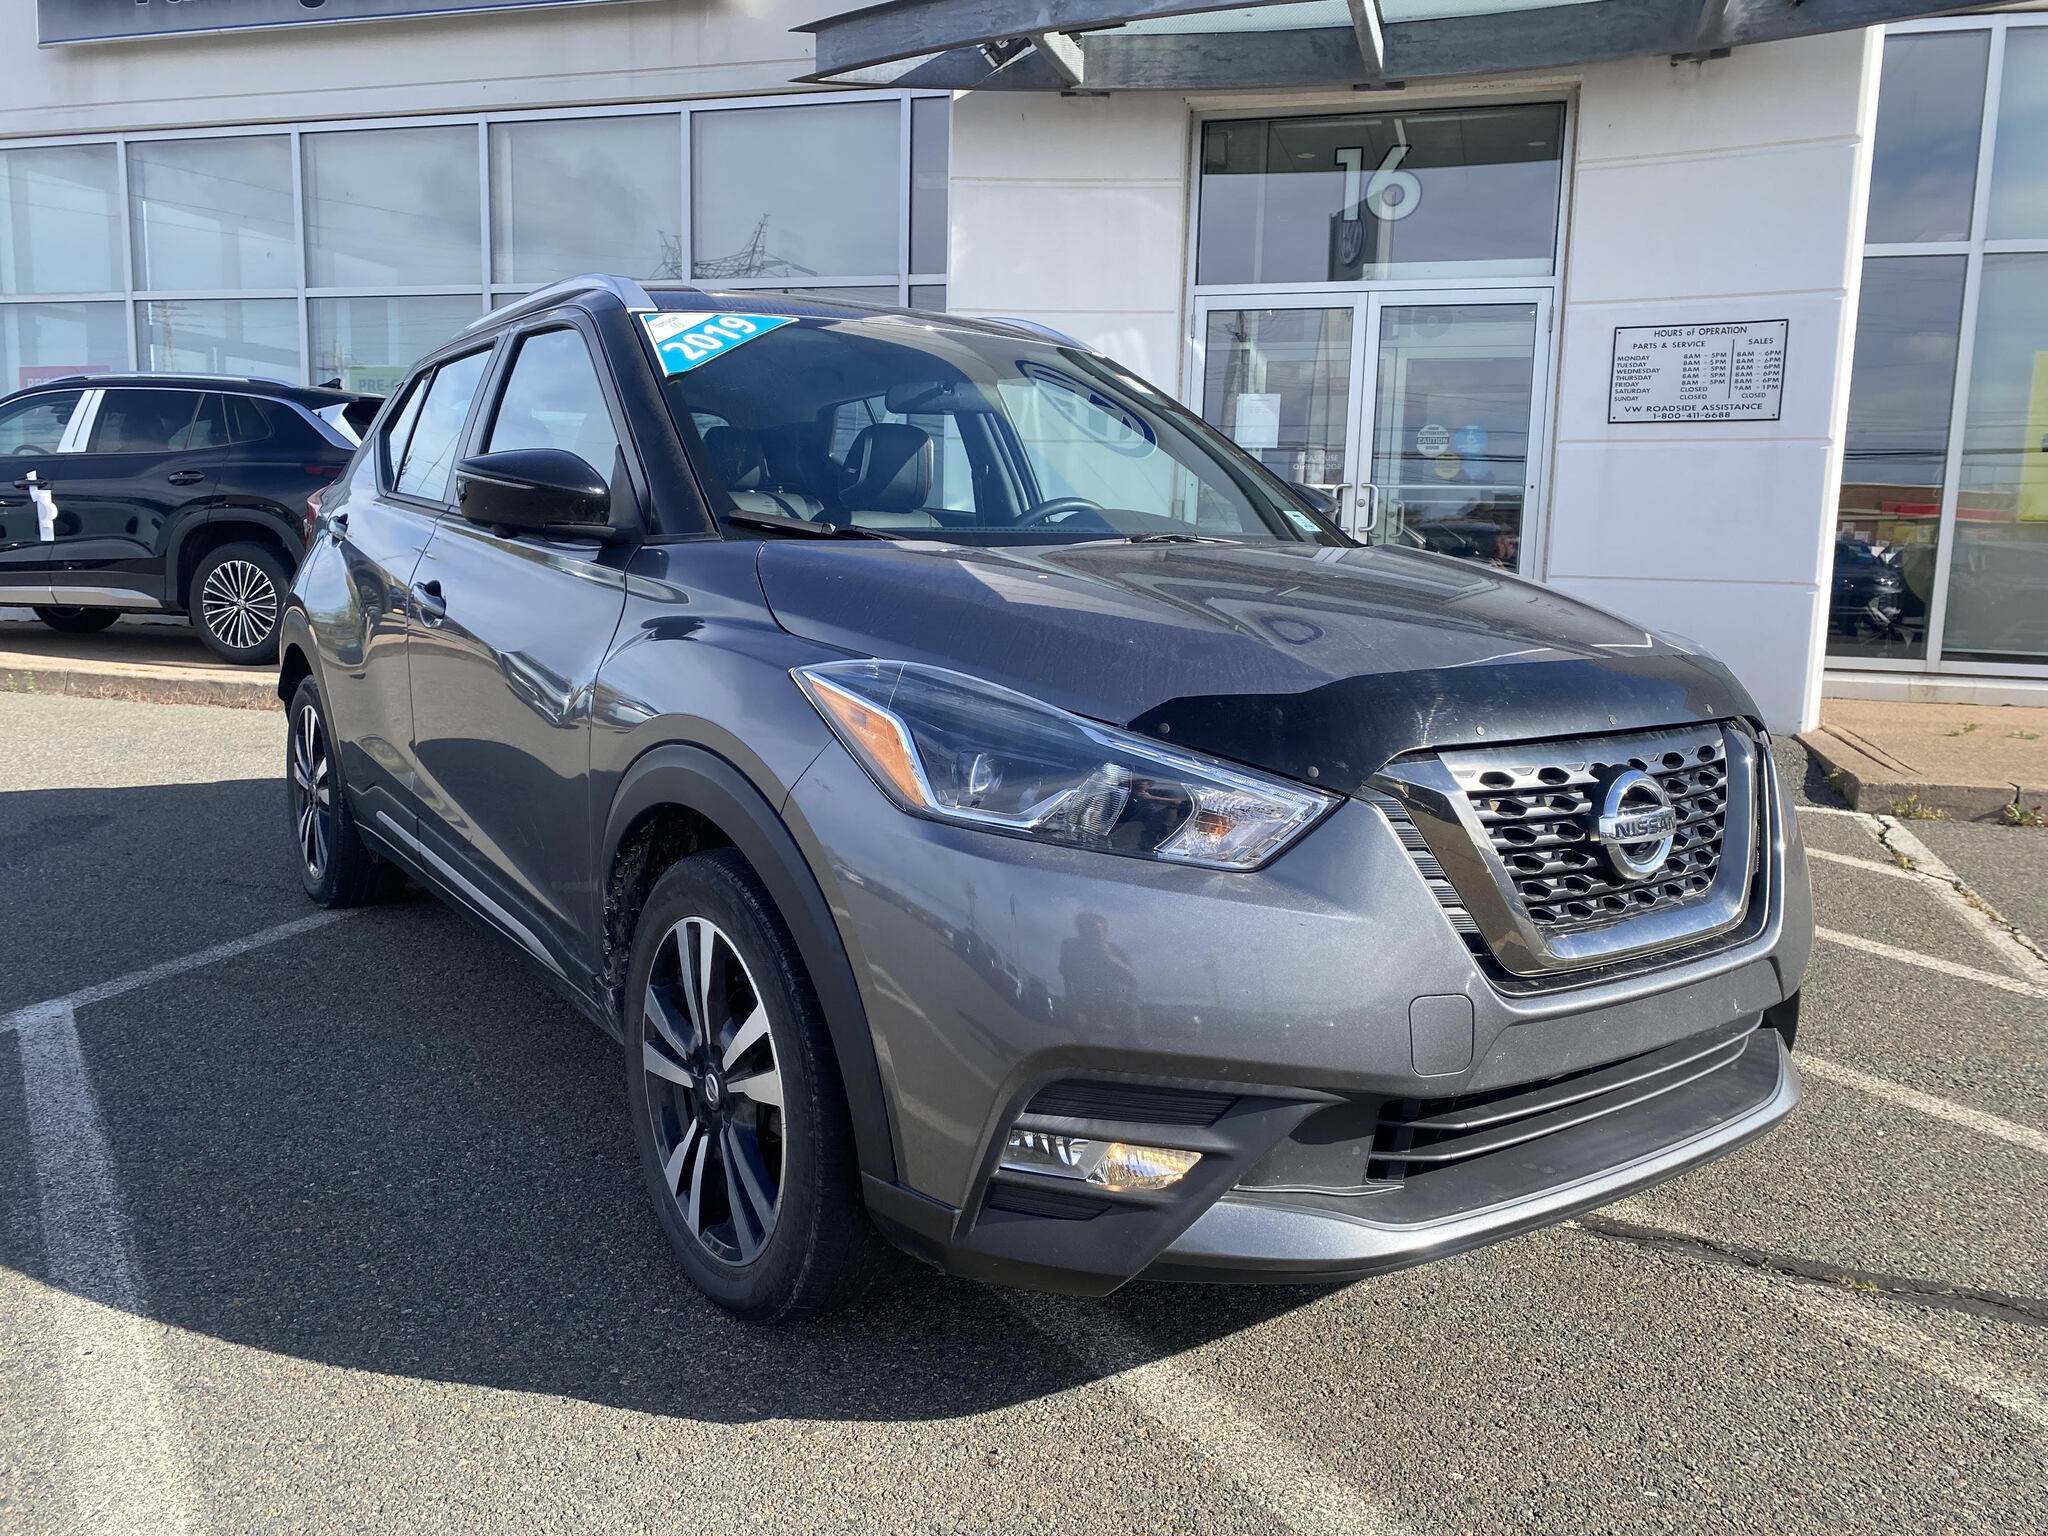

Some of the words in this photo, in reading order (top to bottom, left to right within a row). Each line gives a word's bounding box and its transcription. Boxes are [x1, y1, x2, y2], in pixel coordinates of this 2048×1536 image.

[1334, 144, 1422, 221] 16
[1654, 328, 1683, 337] HOURS
[1686, 328, 1695, 336] of
[1698, 326, 1747, 336] OPERATION
[662, 317, 757, 360] 2019
[1672, 340, 1706, 348] SERVICE
[1646, 404, 1697, 412] ROADSIDE
[1701, 403, 1763, 411] ASSISTANCE
[1653, 411, 1731, 419] 1-800-411-6688
[1615, 816, 1676, 838] NISSAN
